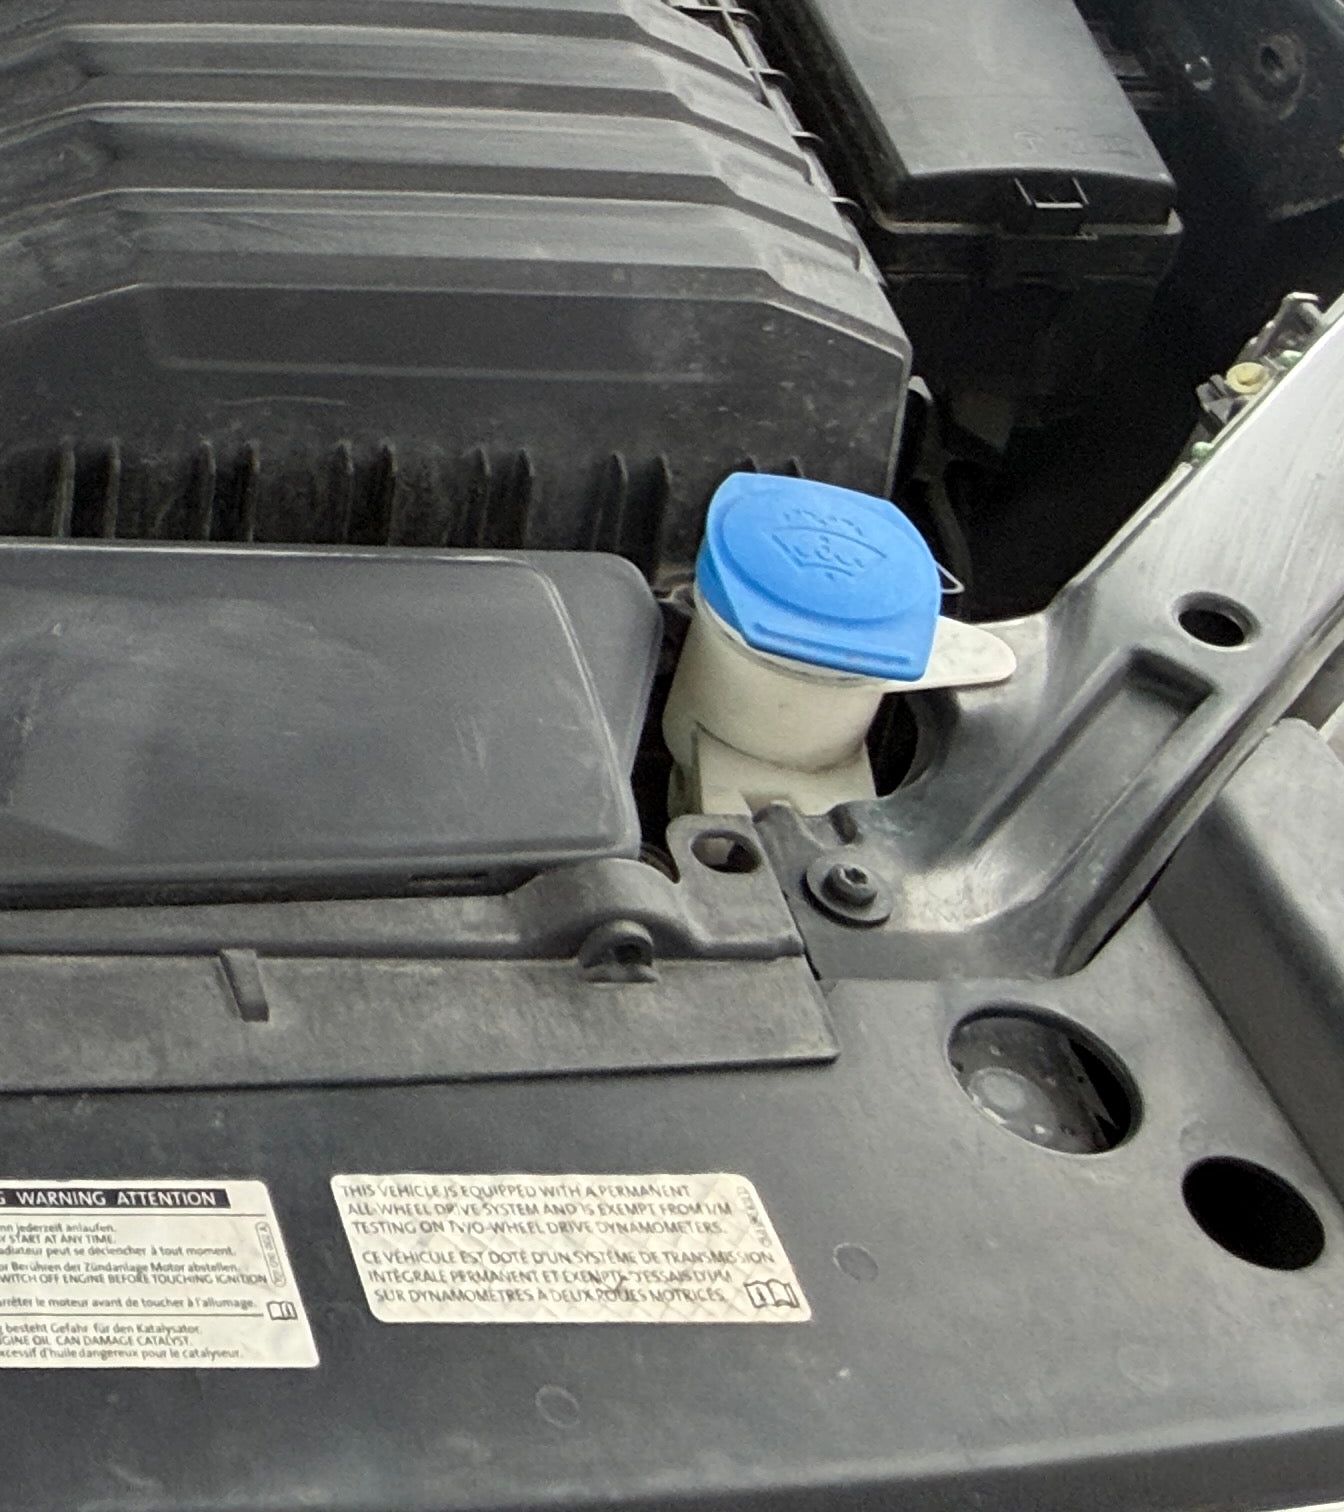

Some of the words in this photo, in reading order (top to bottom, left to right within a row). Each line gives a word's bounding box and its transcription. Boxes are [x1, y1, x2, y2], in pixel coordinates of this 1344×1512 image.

[16, 1191, 107, 1206] WARNING
[117, 1191, 216, 1206] ATTENTION
[343, 1185, 375, 1197] THIS
[378, 1186, 440, 1197] VEHICLE
[444, 1186, 458, 1197] IS
[462, 1185, 536, 1201] EQUIPPED
[541, 1186, 581, 1197] WITH
[599, 1186, 691, 1197] PERMANENT
[485, 1203, 539, 1215] SYSTEM
[544, 1204, 576, 1215] AND
[599, 1203, 654, 1215] EXEMPT
[661, 1203, 702, 1215] FROM
[352, 1221, 416, 1234] TESTING
[420, 1221, 445, 1233] ON
[547, 1221, 593, 1233] DRIVE
[11, 1235, 40, 1244] START
[45, 1235, 56, 1244] AT
[61, 1235, 82, 1244] ANY
[47, 1247, 71, 1258] peut
[163, 1247, 182, 1255] tout
[363, 1251, 381, 1264] CE
[384, 1249, 455, 1264] VÉHICULE
[462, 1251, 482, 1263] EST
[489, 1250, 528, 1264] DOTÉ
[532, 1251, 570, 1264] D'UN
[642, 1251, 658, 1263] DE
[666, 1251, 775, 1264] TRANSMISSION
[12, 1262, 61, 1272] Berühren
[64, 1263, 83, 1272] der
[85, 1262, 148, 1275] Zündanlage
[151, 1263, 184, 1272] Motor
[39, 1274, 59, 1283] OFF
[64, 1274, 104, 1284] ENGINE
[109, 1275, 149, 1284] BEFORE
[154, 1275, 212, 1284] TOUCHING
[369, 1269, 447, 1283] INTÉGRALE
[451, 1270, 537, 1283] PERMANENT
[543, 1271, 557, 1282] ET
[375, 1289, 404, 1302] SUR
[552, 1290, 591, 1301] DEUX
[48, 1298, 88, 1307] moteur
[92, 1299, 122, 1307] avant
[125, 1298, 139, 1307] de
[142, 1298, 183, 1307] toucher
[6, 1323, 48, 1333] besteht
[50, 1323, 88, 1333] Gefahr
[93, 1323, 109, 1333] für
[113, 1324, 133, 1333] den
[32, 1337, 51, 1346] OIL
[56, 1337, 81, 1346] CAN
[84, 1337, 133, 1346] DAMAGE
[40, 1348, 76, 1358] d'huile
[80, 1348, 136, 1360] dangereux
[142, 1350, 167, 1359] pour
